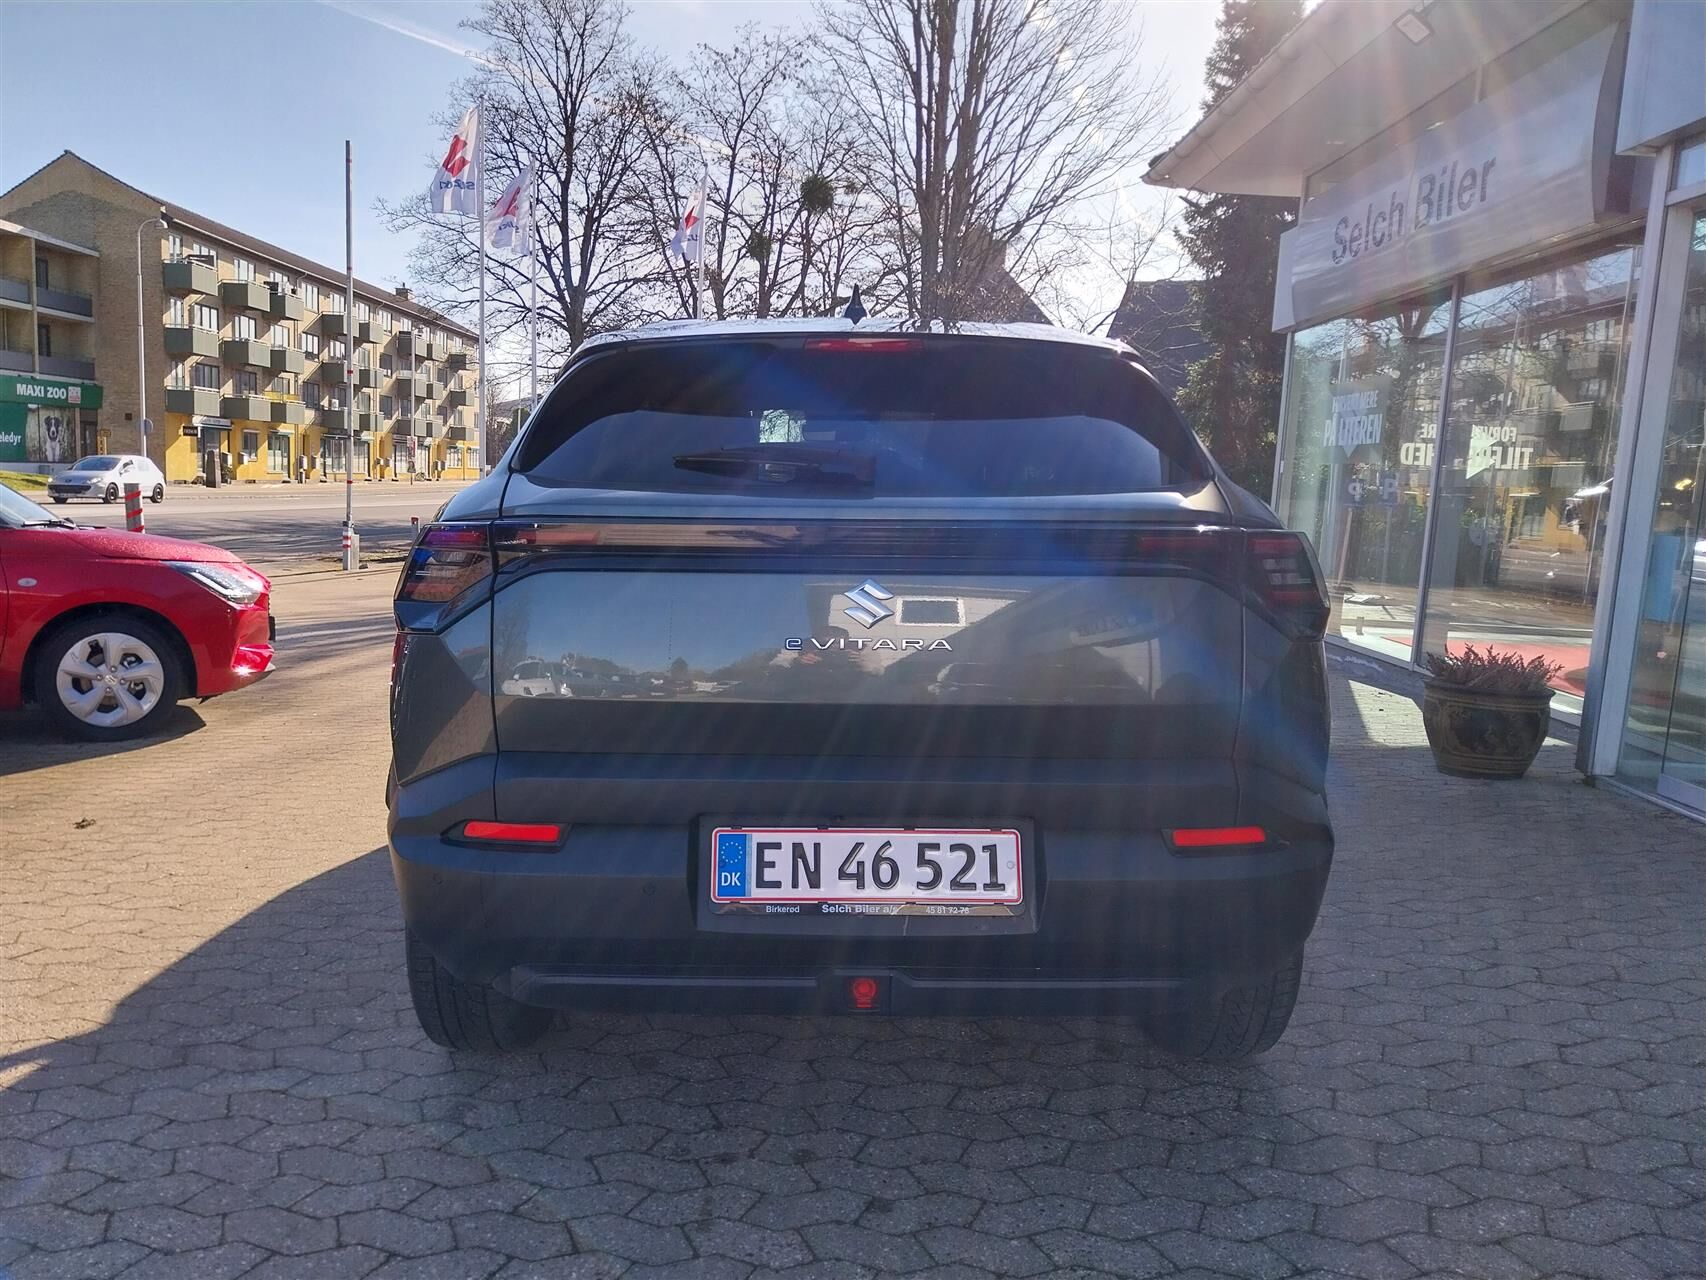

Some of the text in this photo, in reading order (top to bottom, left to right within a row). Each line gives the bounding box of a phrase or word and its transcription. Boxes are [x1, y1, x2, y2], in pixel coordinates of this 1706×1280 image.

[1331, 156, 1497, 265] Selch Biler
[16, 383, 67, 399] MAXI ZOO
[810, 637, 953, 652] VITARA
[755, 840, 1006, 892] EN 46 521
[720, 871, 741, 887] DK
[821, 904, 852, 914] Selch
[854, 904, 881, 914] Biler
